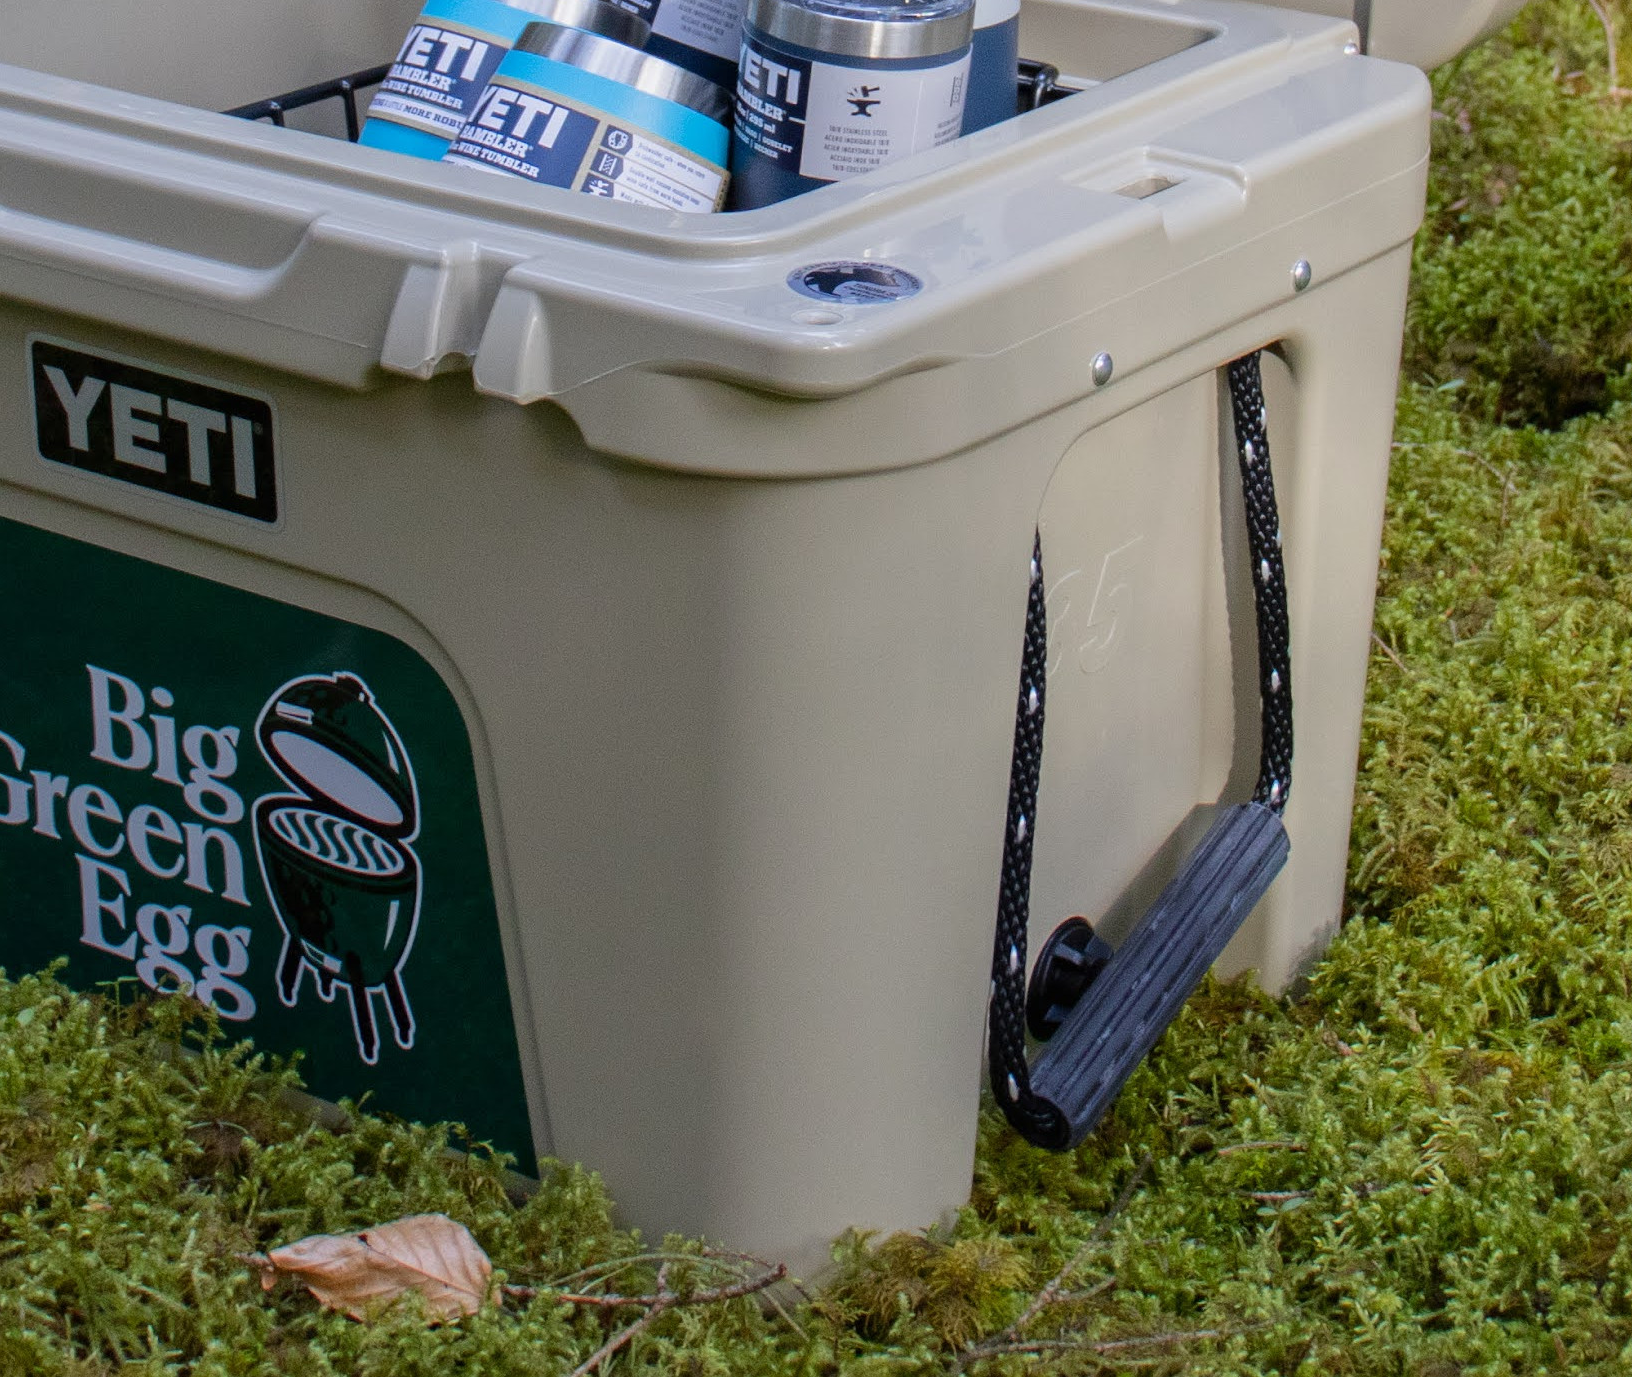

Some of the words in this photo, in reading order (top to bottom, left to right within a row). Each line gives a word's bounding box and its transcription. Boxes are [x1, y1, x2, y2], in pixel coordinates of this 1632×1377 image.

[403, 104, 432, 119] MORE
[406, 85, 463, 109] TUMBLER
[468, 85, 569, 148] YETI
[749, 113, 763, 127] 295
[764, 122, 775, 133] ml
[481, 147, 539, 177] TUMBLER
[42, 364, 256, 499] YETI
[86, 664, 244, 824] Big
[75, 852, 256, 1022] Egg
